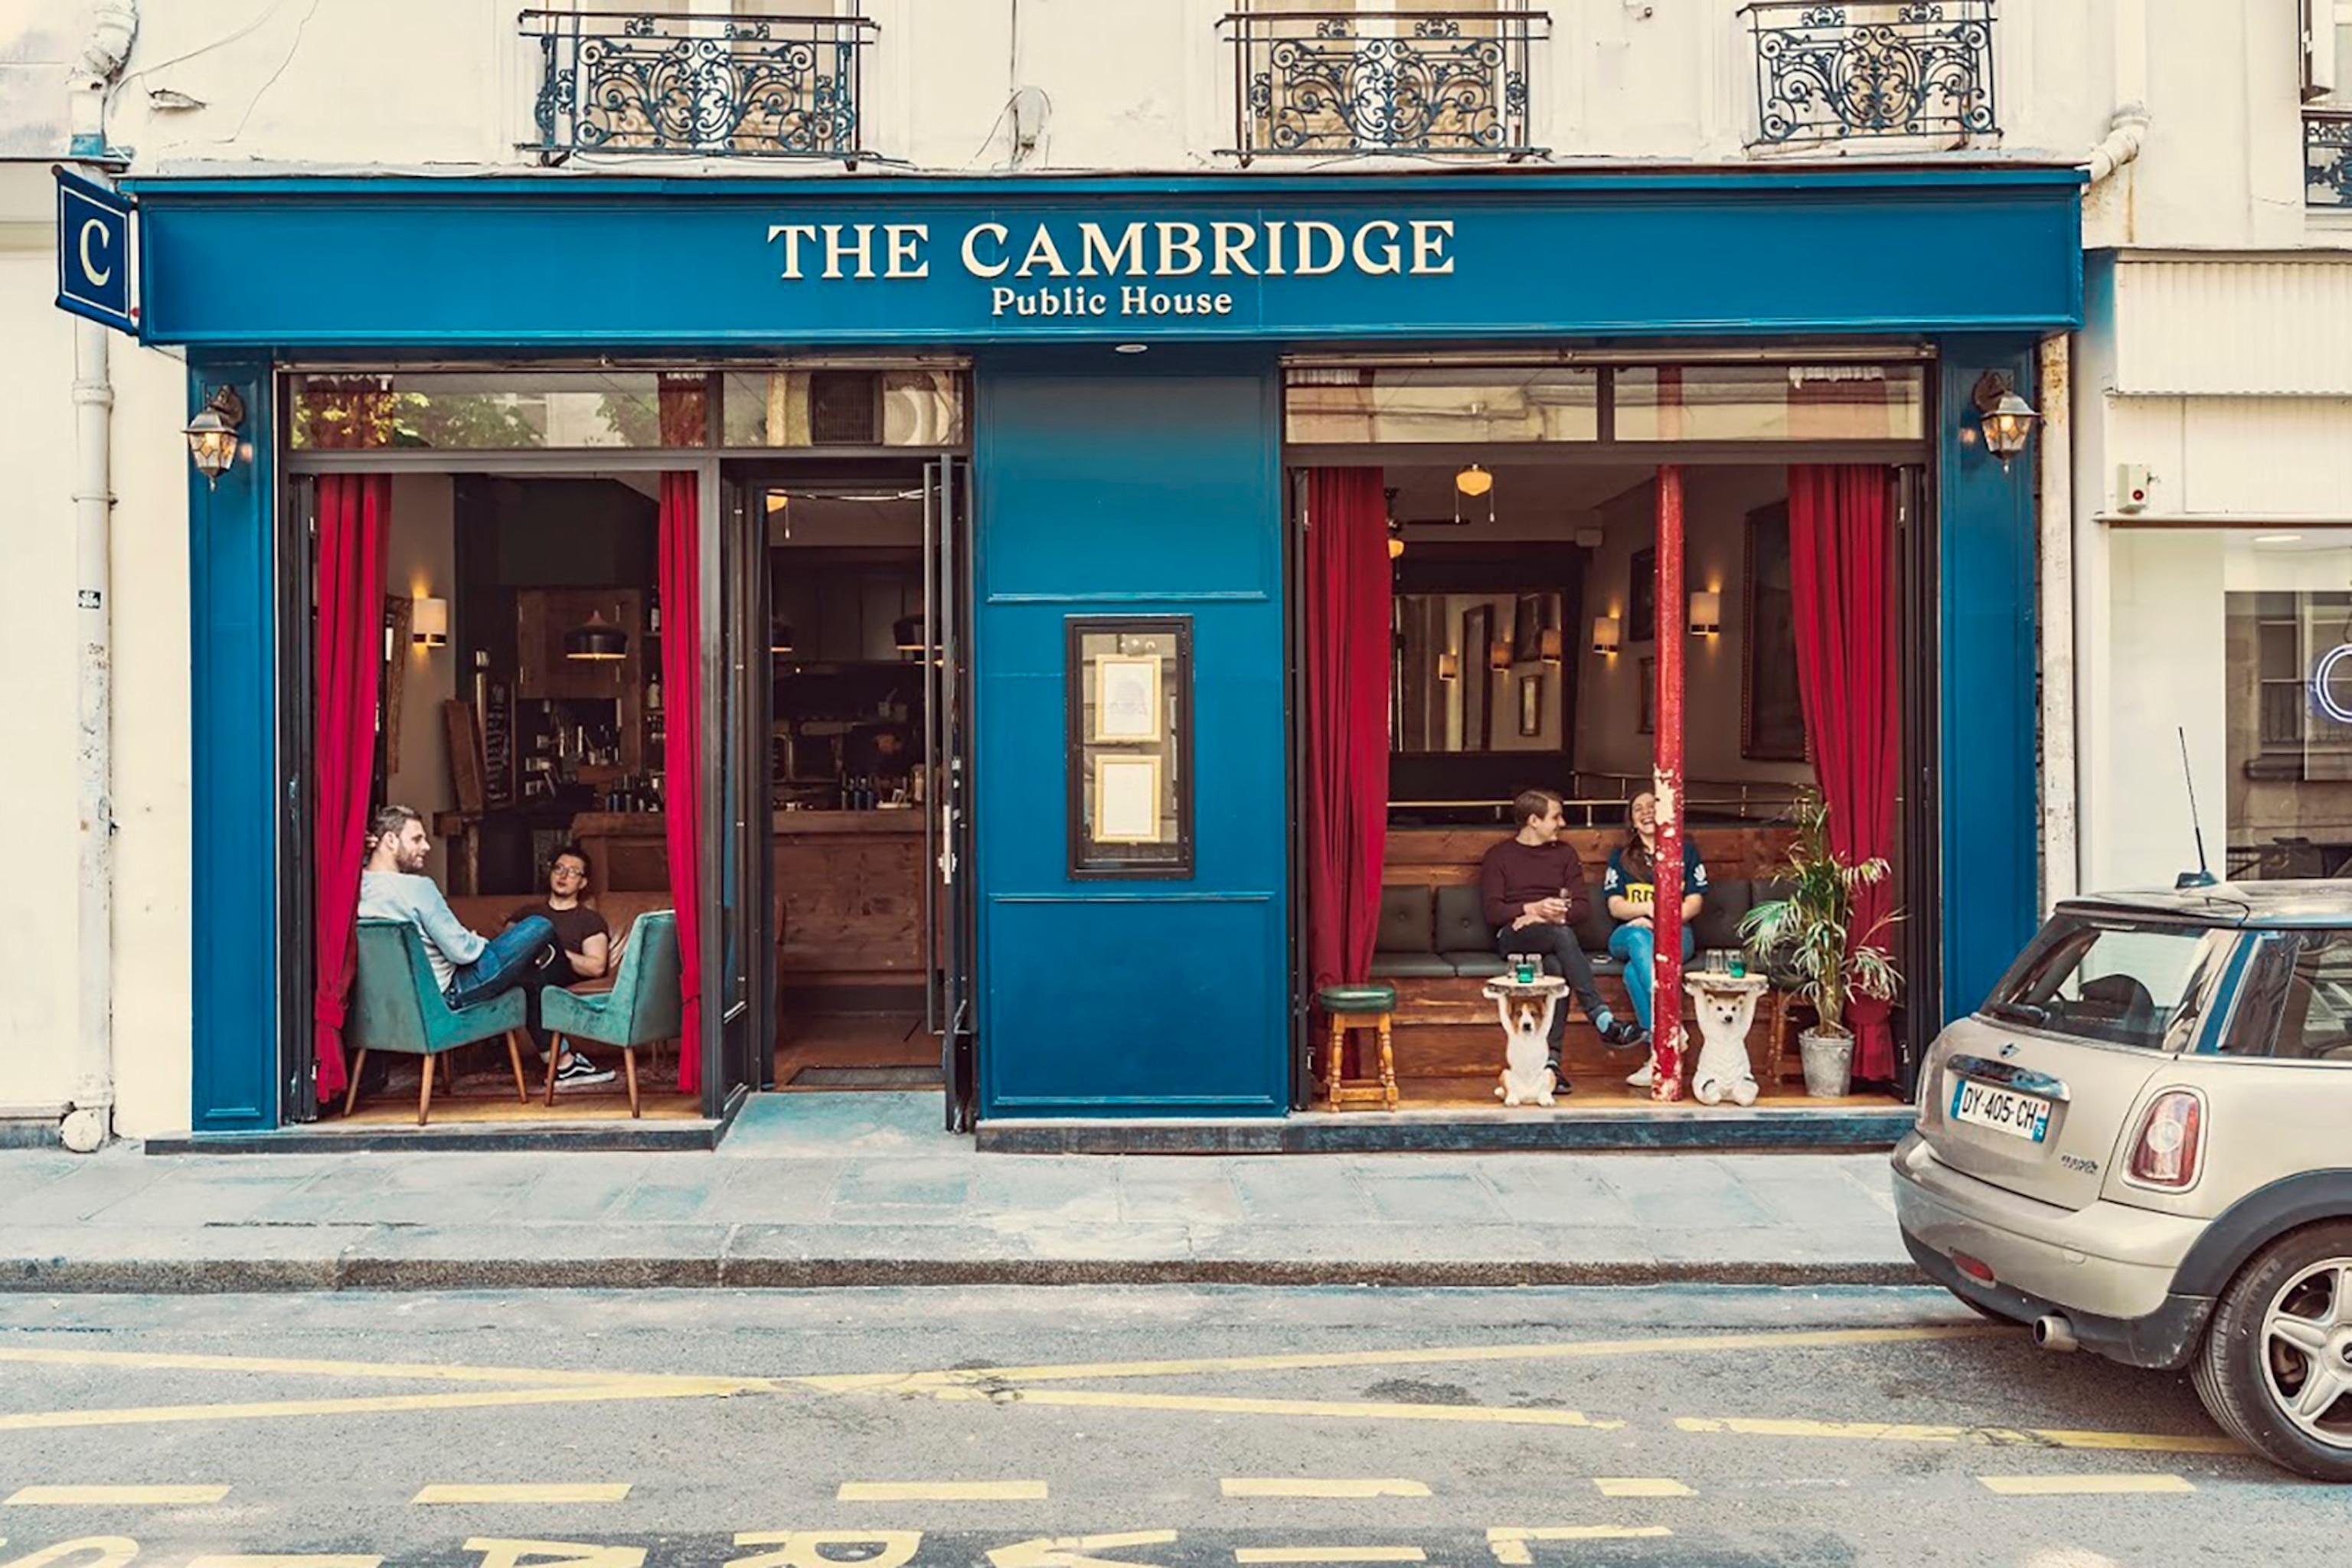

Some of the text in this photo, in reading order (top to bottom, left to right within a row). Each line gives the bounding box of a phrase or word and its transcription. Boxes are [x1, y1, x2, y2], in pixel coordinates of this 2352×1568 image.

[80, 218, 110, 286] C
[767, 220, 1455, 278] THE CAMBRIDGE
[991, 286, 1233, 316] Public House
[1962, 1086, 2039, 1131] DY-405-CH
